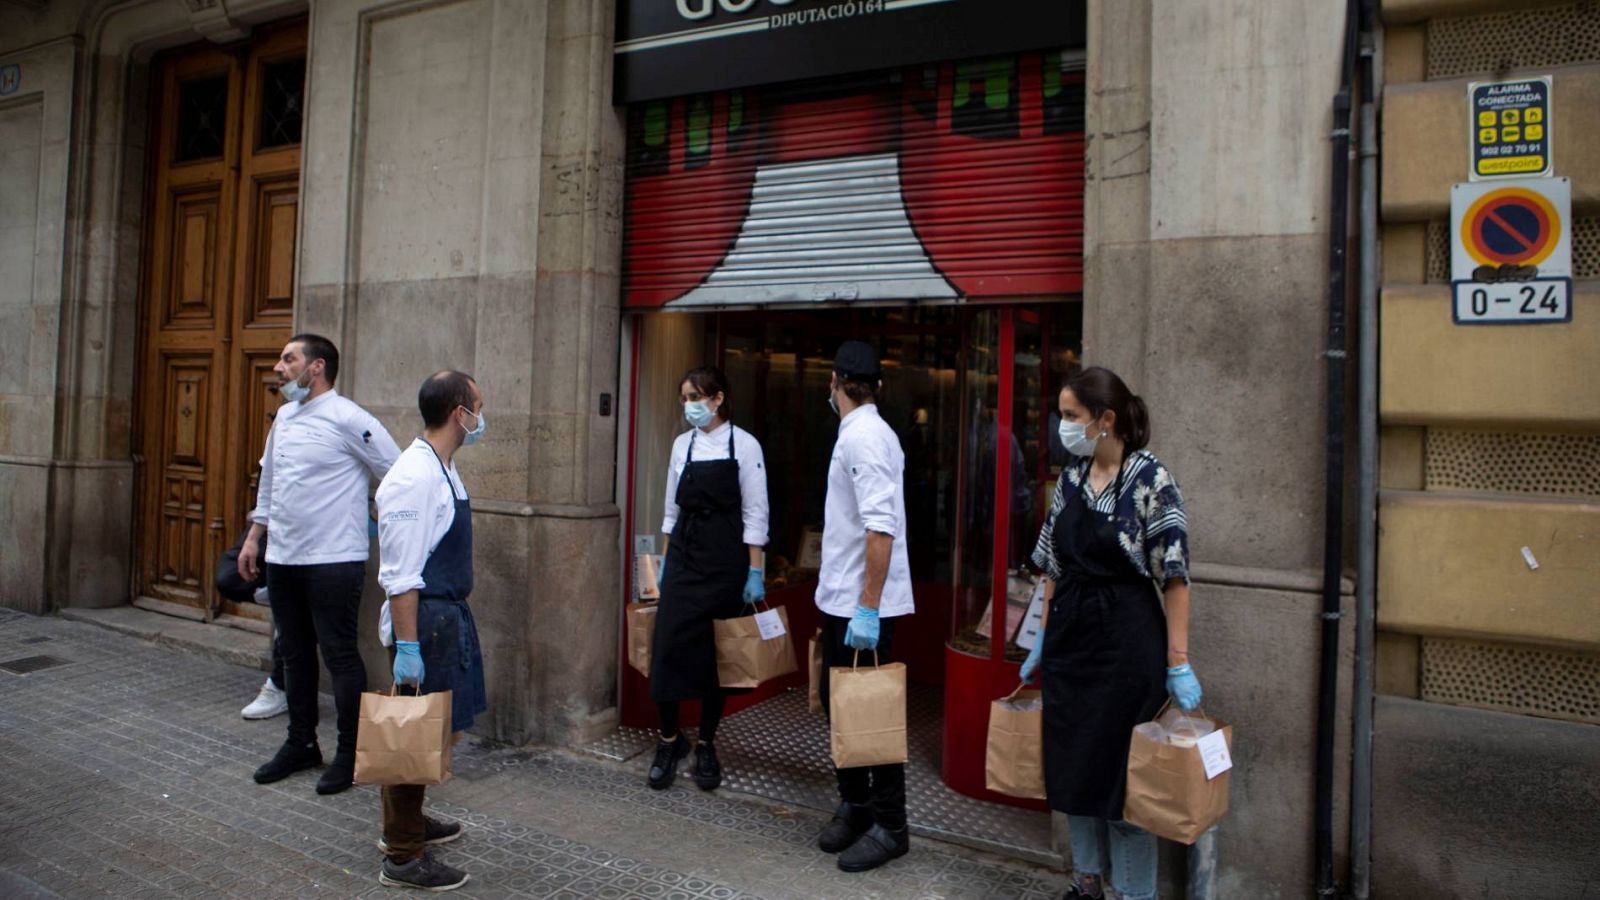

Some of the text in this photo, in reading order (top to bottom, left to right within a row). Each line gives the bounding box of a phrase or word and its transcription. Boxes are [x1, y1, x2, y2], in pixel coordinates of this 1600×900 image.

[770, 0, 884, 29] DIPUTACIÓ 164
[1487, 83, 1531, 95] ALARMA
[1478, 93, 1542, 107] CONECTADA
[1500, 145, 1513, 155] 02
[1515, 144, 1528, 154] 70
[1529, 143, 1541, 153] 91
[1520, 285, 1559, 314] 24
